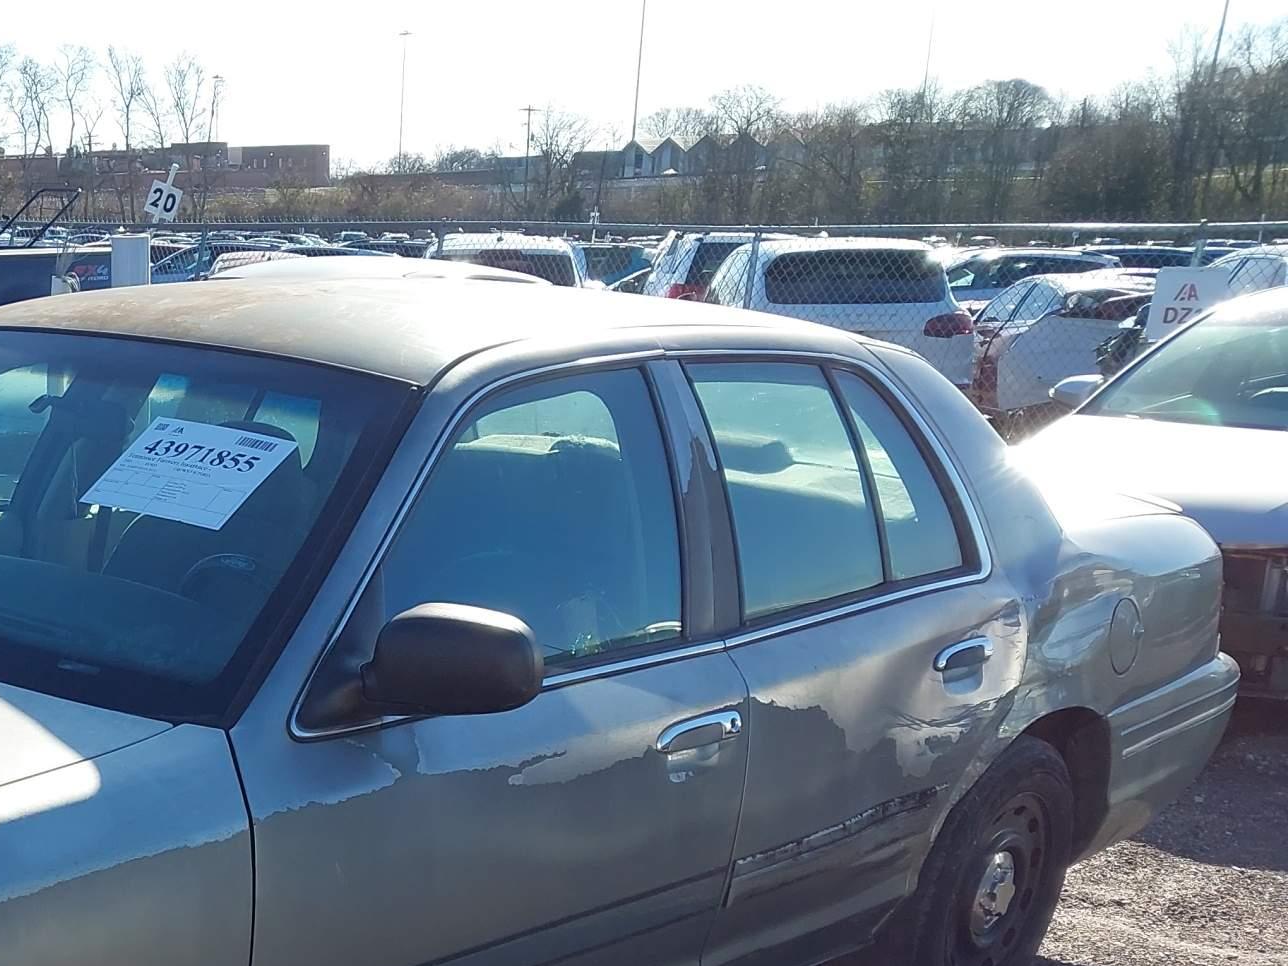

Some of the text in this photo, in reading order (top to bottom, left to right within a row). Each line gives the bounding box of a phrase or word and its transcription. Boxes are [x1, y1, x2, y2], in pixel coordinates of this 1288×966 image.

[149, 187, 177, 213] 20
[1162, 306, 1203, 325] DZ
[144, 438, 262, 474] 43971855
